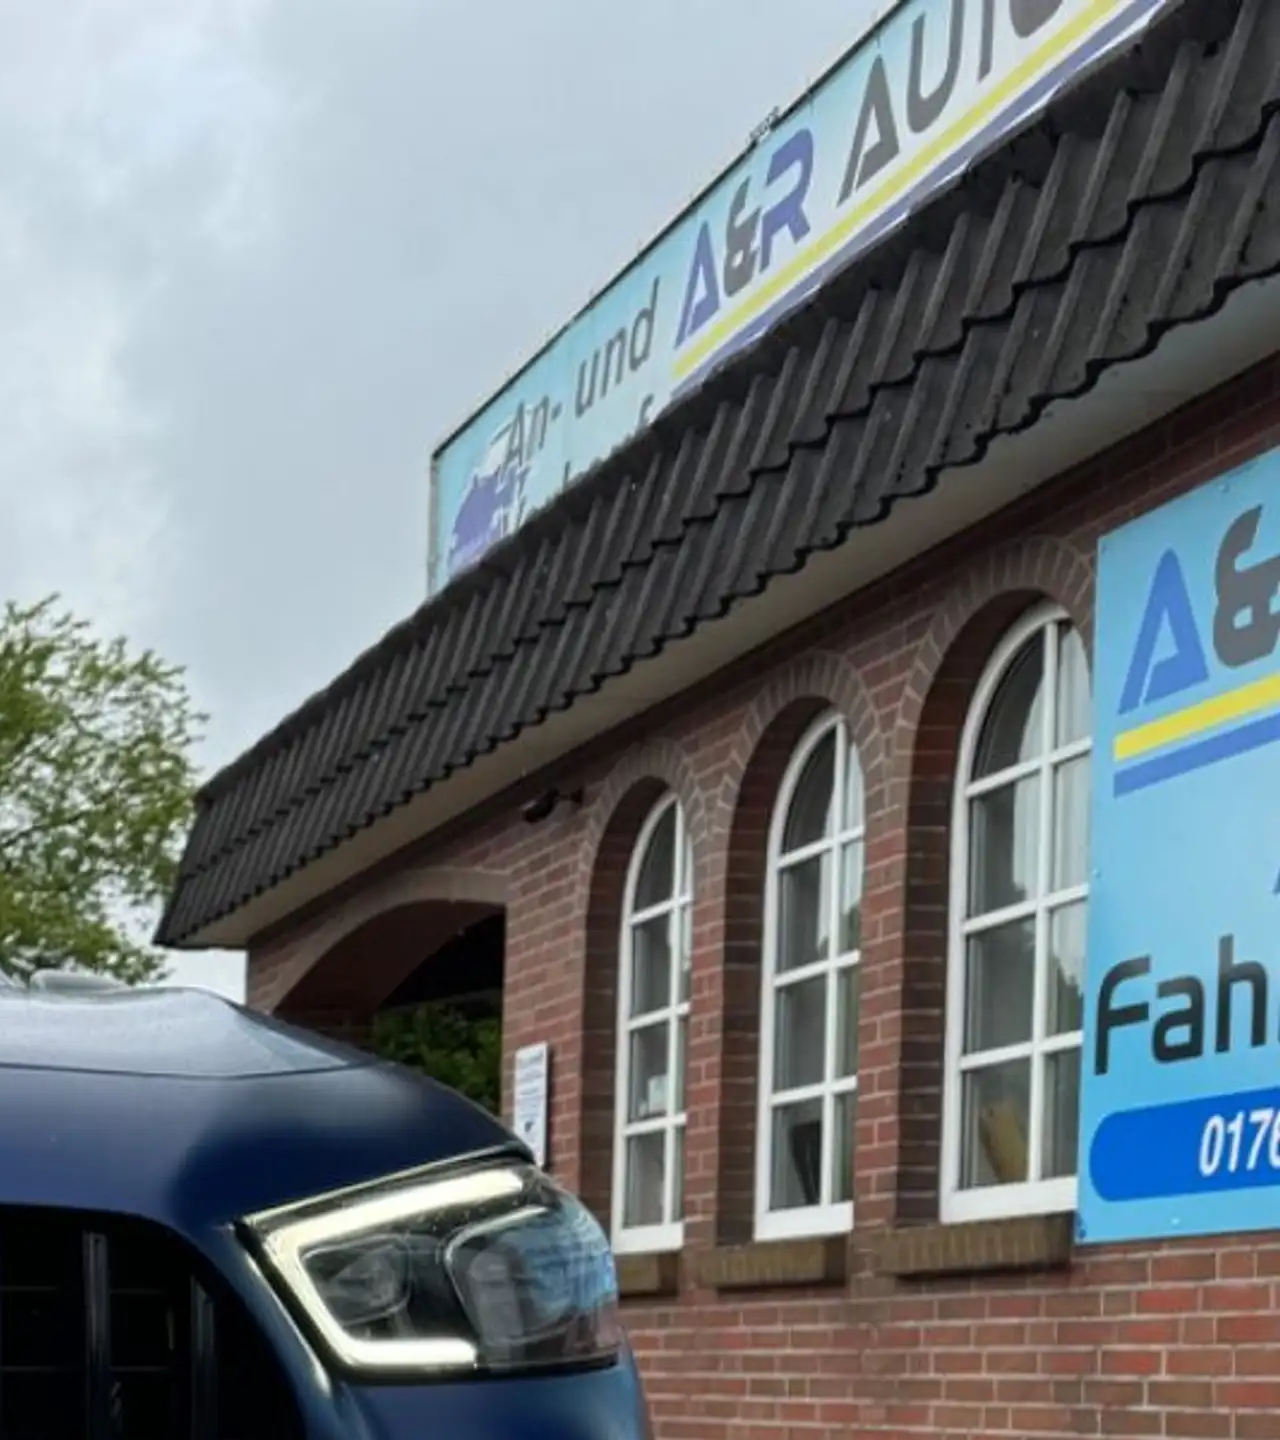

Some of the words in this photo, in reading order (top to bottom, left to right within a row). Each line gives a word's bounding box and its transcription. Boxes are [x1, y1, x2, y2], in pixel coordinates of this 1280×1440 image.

[674, 127, 815, 351] A&R
[837, 0, 1064, 208] AUT
[575, 275, 660, 418] und
[1094, 933, 1280, 1076] Fah
